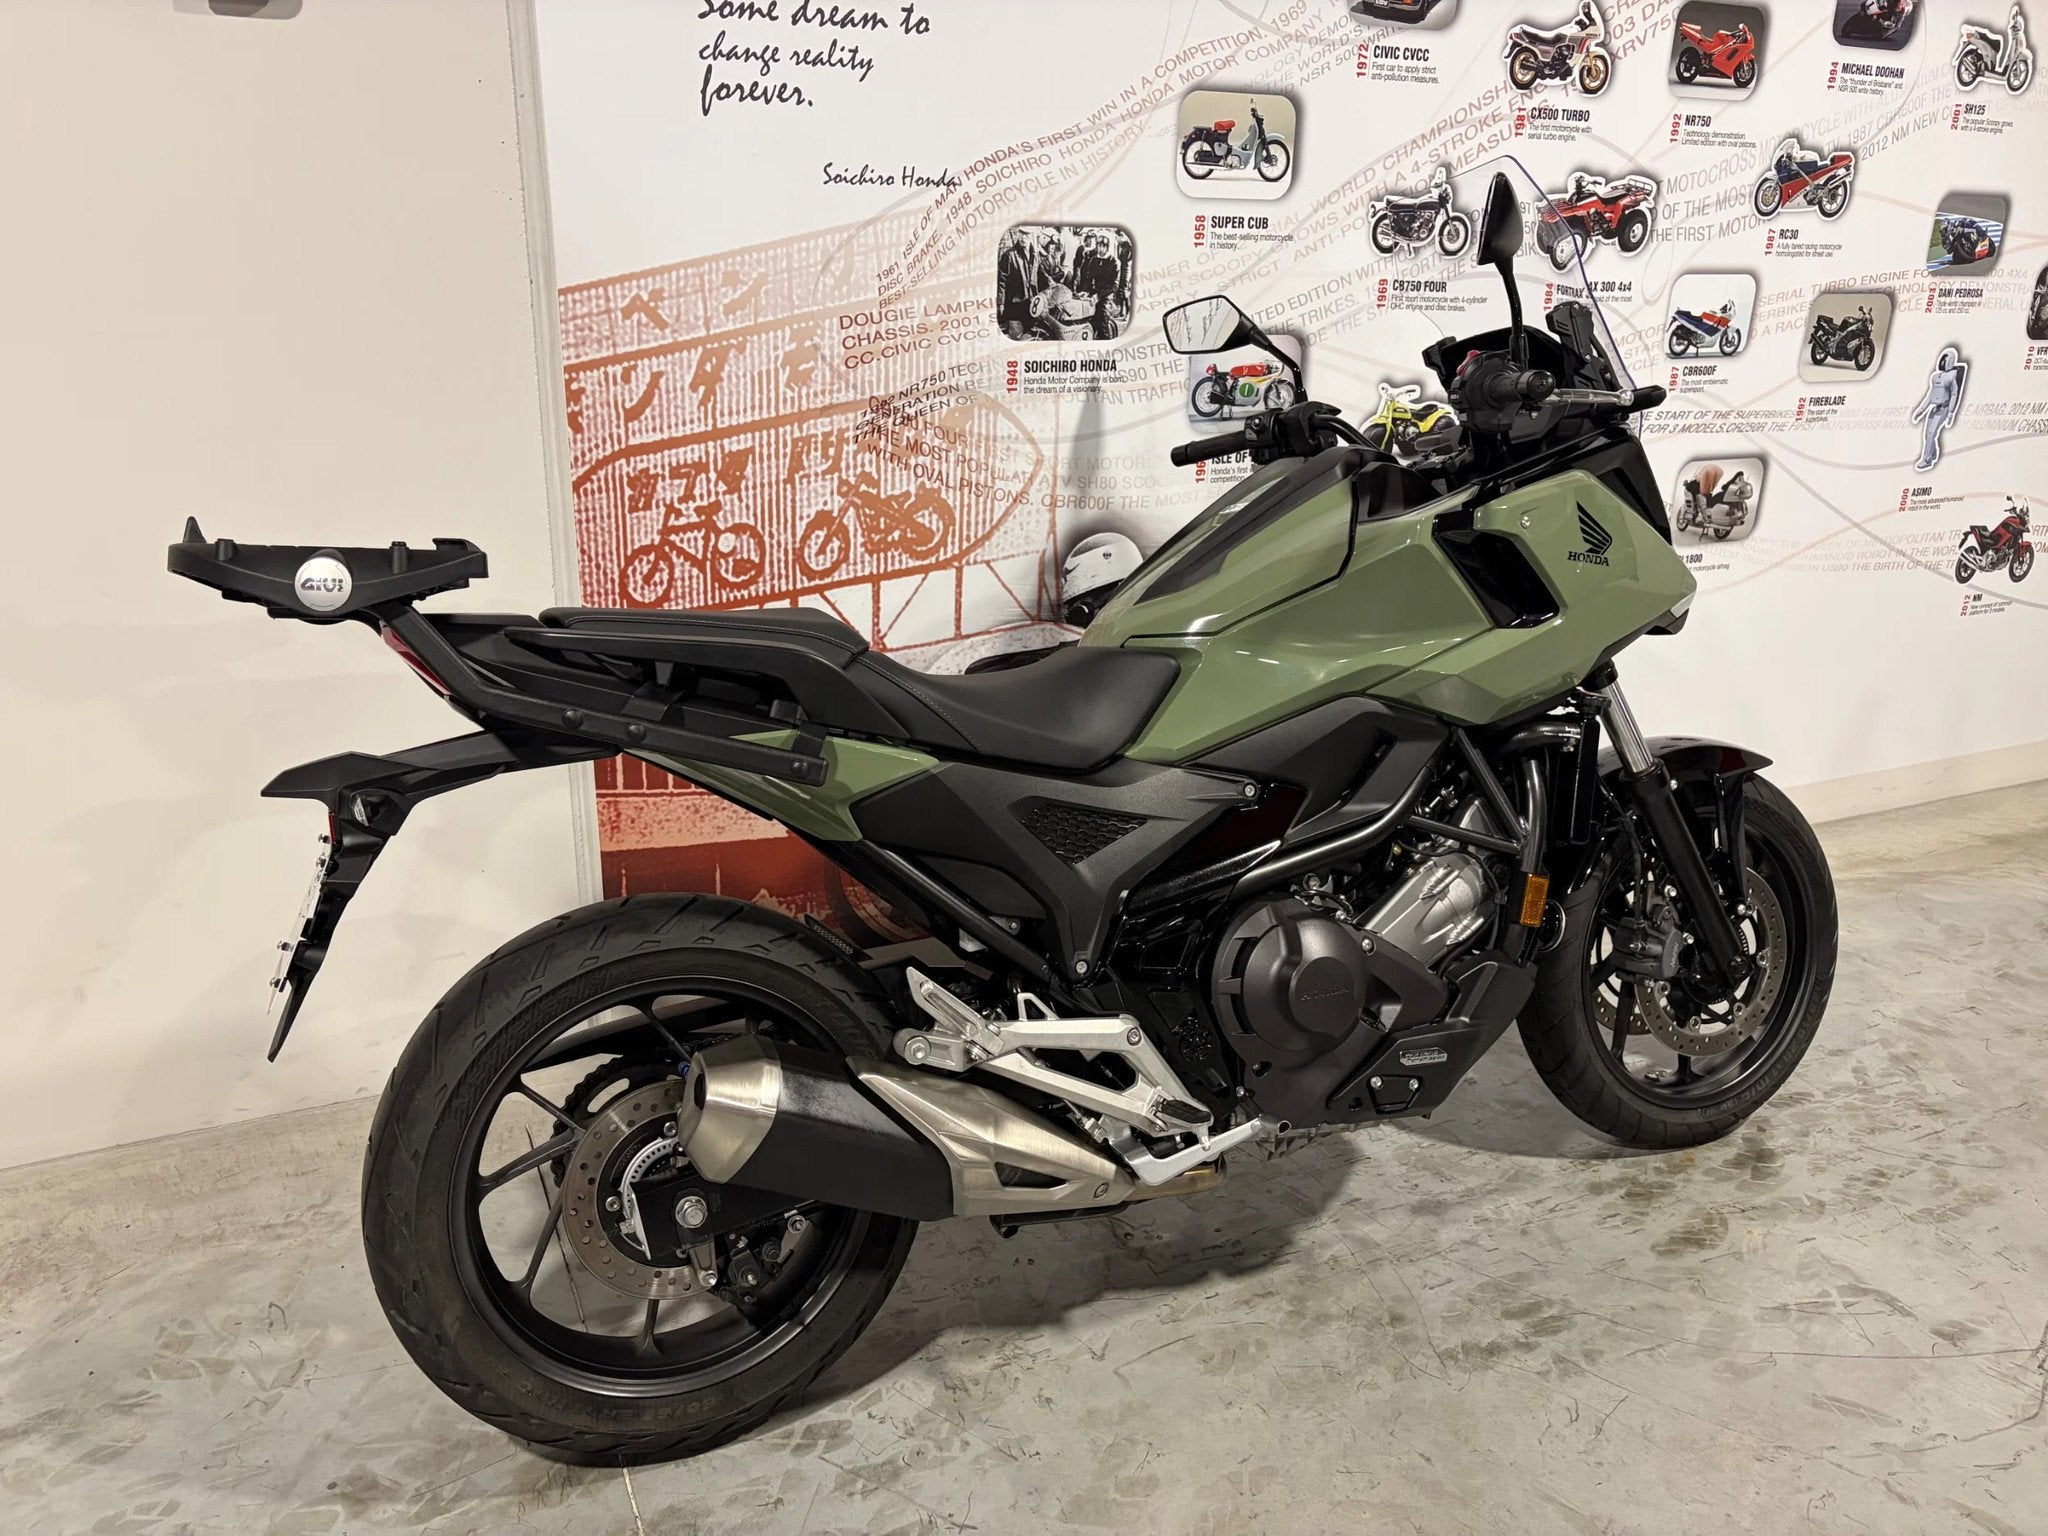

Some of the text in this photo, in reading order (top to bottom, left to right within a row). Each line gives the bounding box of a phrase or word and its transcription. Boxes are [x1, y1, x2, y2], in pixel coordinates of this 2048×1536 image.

[698, 0, 931, 35] Some dream to
[699, 30, 874, 82] change reality
[1357, 43, 1369, 78] 1972
[1373, 45, 1430, 62] CIVIC CVCC
[1404, 65, 1420, 75] apply
[1827, 61, 1839, 90] 1994
[1841, 62, 1904, 79] MICHAEL DOOHAN
[700, 63, 814, 117] forever.
[1530, 107, 1590, 122] CX500 TURBO
[1684, 114, 1712, 127] NR750
[1950, 104, 1962, 129] 2001
[1964, 103, 1986, 116] SH125
[1514, 107, 1527, 138] 1981
[1670, 113, 1682, 144] 1992
[876, 2, 1307, 283] 1961 ISLE OF MAN HONDA'S FIRST WIN IN A COMPETITION. 1969
[877, 14, 1324, 297] DISC 1948 SOICHIRO HONDA HONDA MOTOR COMPANY
[822, 161, 958, 189] Soichiro Honda
[1676, 110, 1940, 242] FIRST 2012 NM NEW
[1662, 200, 1682, 220] OF
[1683, 194, 1711, 216] THE
[1195, 215, 1207, 248] 1958
[1211, 216, 1269, 230] SUPER CUB
[1779, 229, 1799, 240] RC30
[877, 163, 1079, 309] BEST-SELLING MOTORCYCLE IN
[1210, 232, 1294, 244] The best-selling motorcycle
[1217, 241, 1240, 251] history.
[1764, 228, 1776, 256] 1987
[1290, 272, 1354, 316] EDITION
[1376, 278, 1388, 310] 1969
[1392, 279, 1447, 293] CB750 FOUR
[1543, 282, 1553, 311] 1984
[1600, 281, 1632, 292] 300 4x4
[1758, 269, 1910, 308] SERIAL TURBO ENGINE
[1954, 289, 1984, 298] PEDROSA
[1925, 288, 1936, 313] 2003
[839, 306, 917, 330] DOUGIE
[841, 314, 982, 351] CHASSIS. 2001
[937, 328, 991, 347] CVCC
[1024, 360, 1117, 373] SOICHIRO HONDA
[1151, 359, 1184, 378] THE
[2024, 346, 2035, 370] 2010
[1006, 359, 1019, 394] 1948
[1024, 377, 1046, 385] Honda
[1048, 377, 1068, 385] Motor
[1069, 376, 1100, 387] Company
[1669, 366, 1679, 392] 1987
[1682, 365, 1717, 377] CBR600F
[899, 370, 946, 398] NR750
[1024, 386, 1035, 394] the
[1036, 386, 1057, 394] dream
[1072, 385, 1103, 395] visionary.
[956, 393, 978, 406] OF
[1795, 397, 1807, 423] 1992
[1808, 395, 1846, 407] FIREBLADE
[1655, 411, 1693, 421] START
[1694, 411, 1711, 421] OF
[1711, 410, 1735, 420] THE
[1643, 424, 1668, 434] FOR
[905, 435, 951, 463] MOST
[1235, 451, 1249, 464] OF
[867, 443, 909, 470] WITH
[912, 463, 954, 489] OVAL
[1121, 495, 1151, 509] THE
[1195, 459, 1206, 483] 196
[1211, 467, 1236, 475] Honda's
[1899, 488, 1909, 512] 2000
[1911, 487, 1932, 497] ASIMO
[1567, 551, 1610, 566] HONDA
[1960, 594, 1971, 616] 2012
